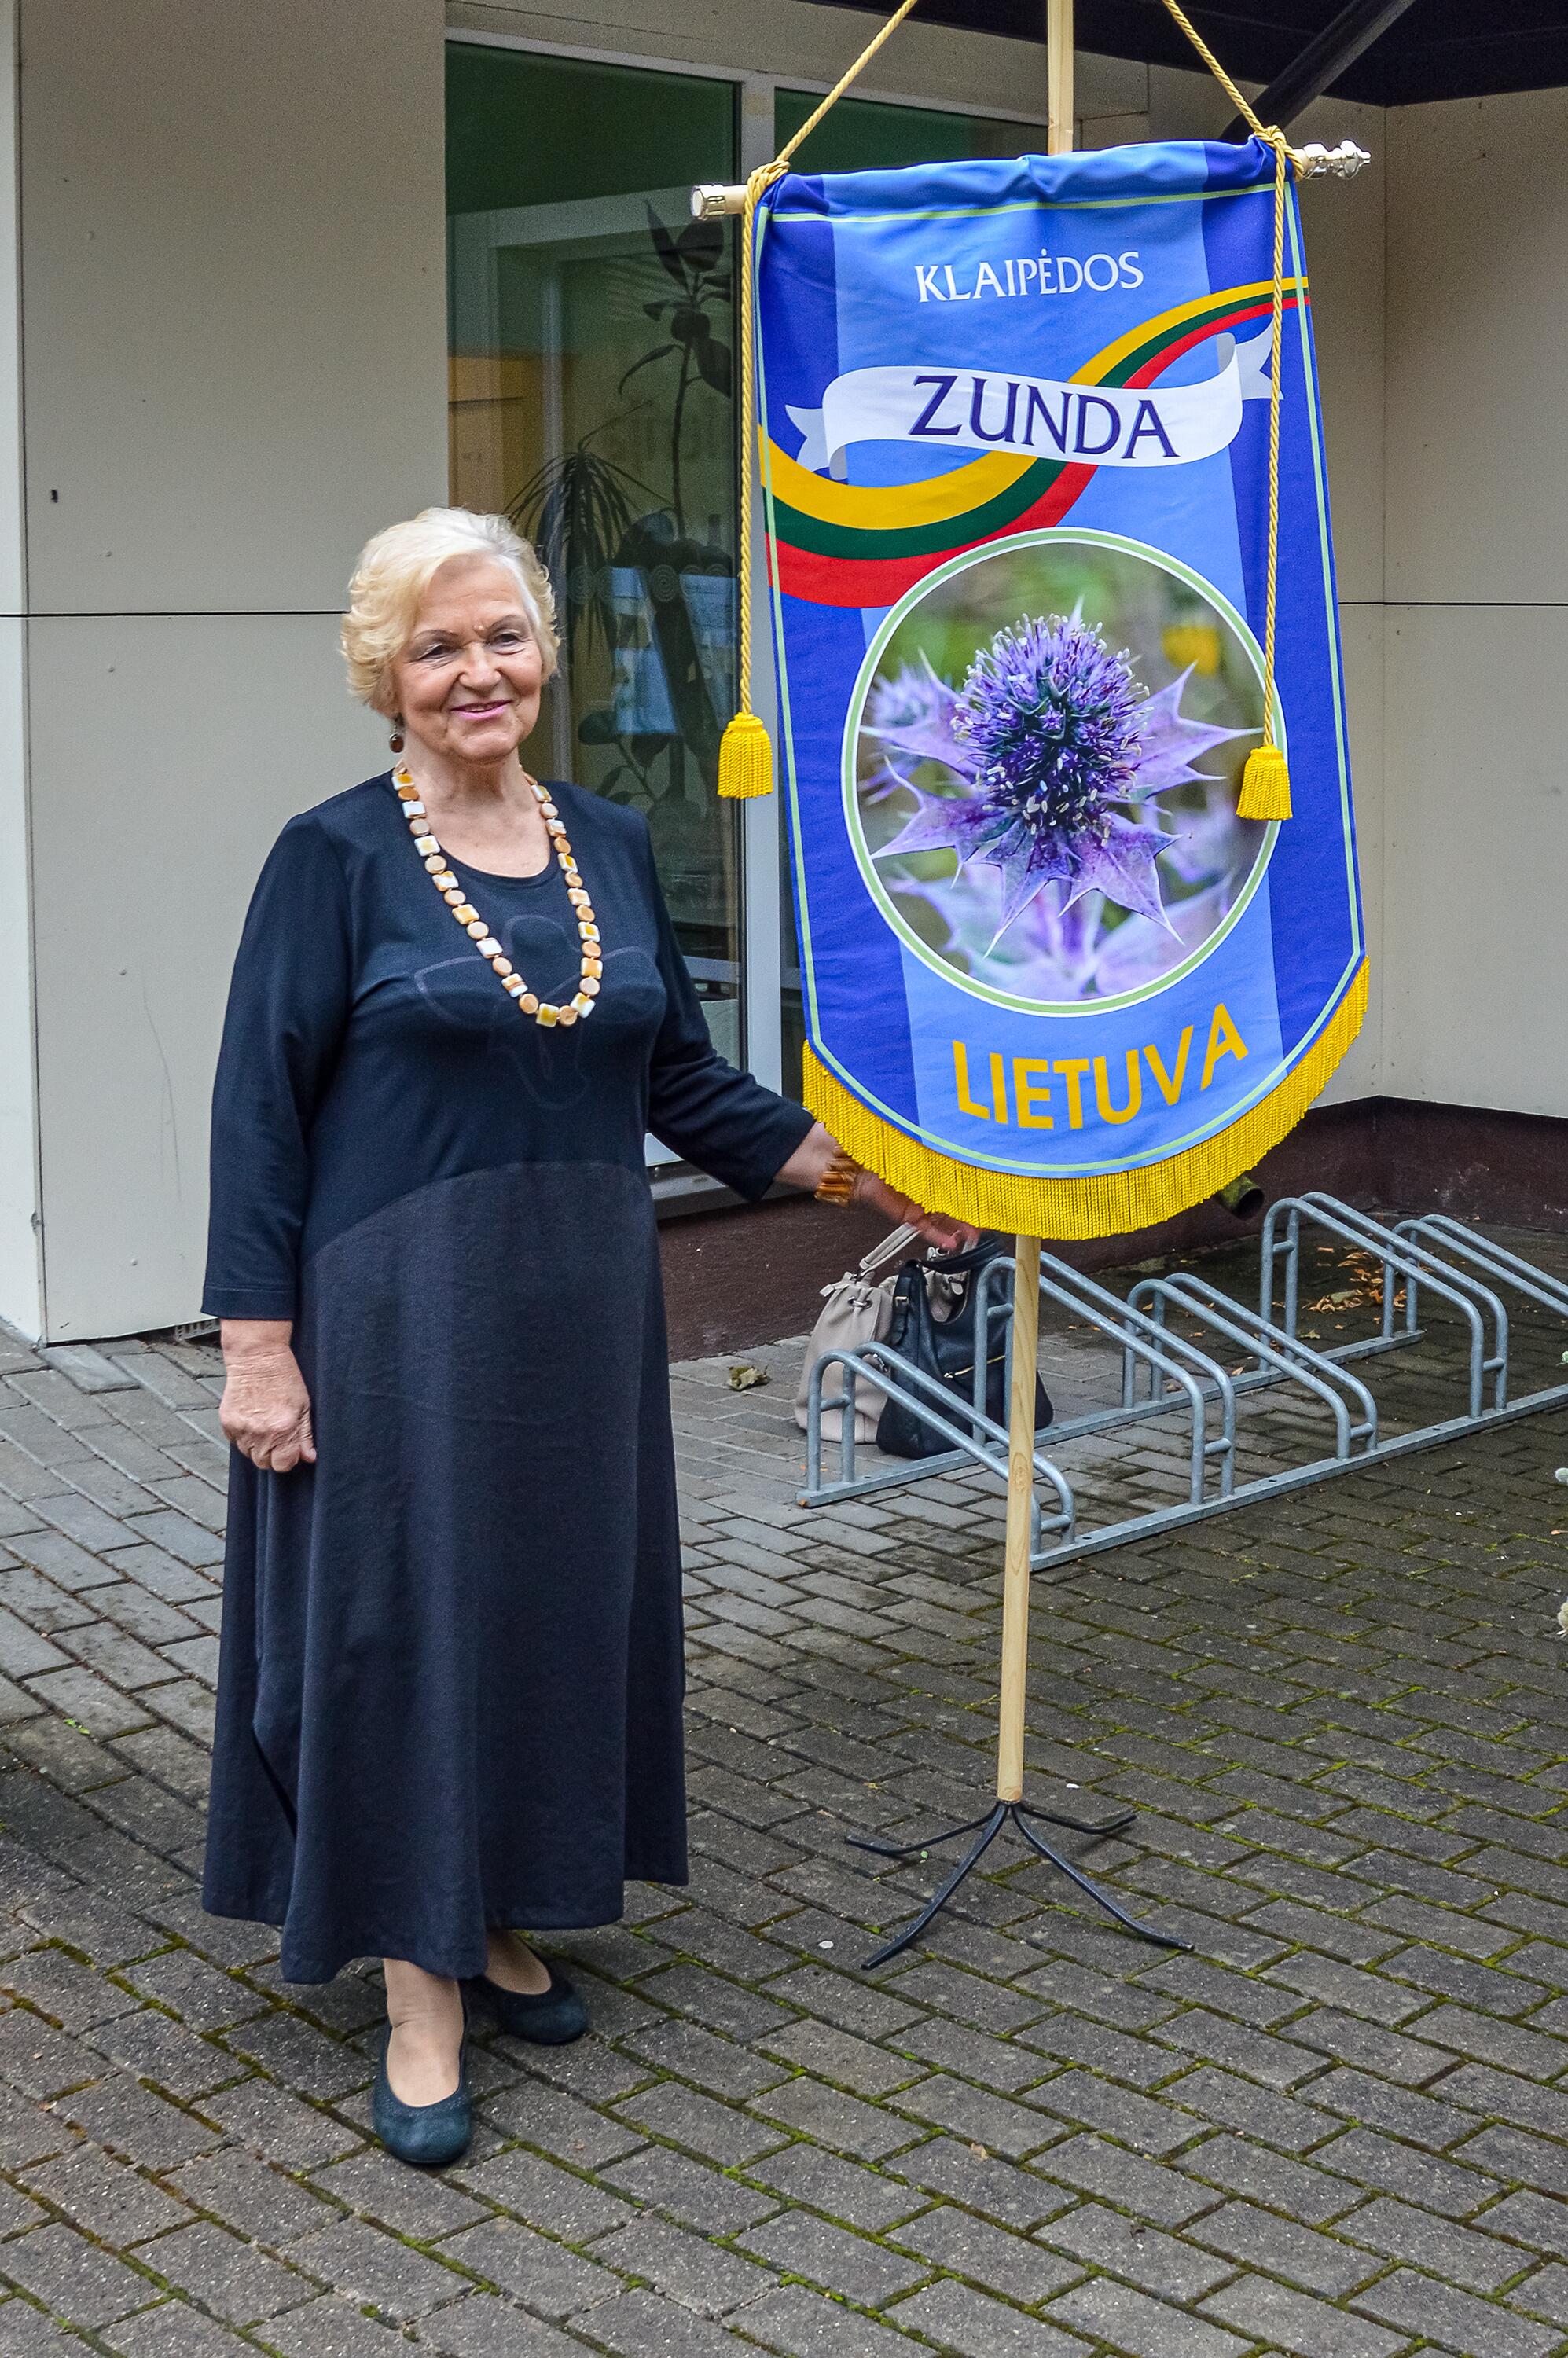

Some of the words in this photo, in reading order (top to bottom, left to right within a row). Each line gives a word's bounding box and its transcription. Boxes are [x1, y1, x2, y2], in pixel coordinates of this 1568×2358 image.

[916, 248, 1144, 303] KLAIPĖDOS
[909, 375, 1179, 458] ZUNDA
[953, 1003, 1248, 1129] LIETUVA
